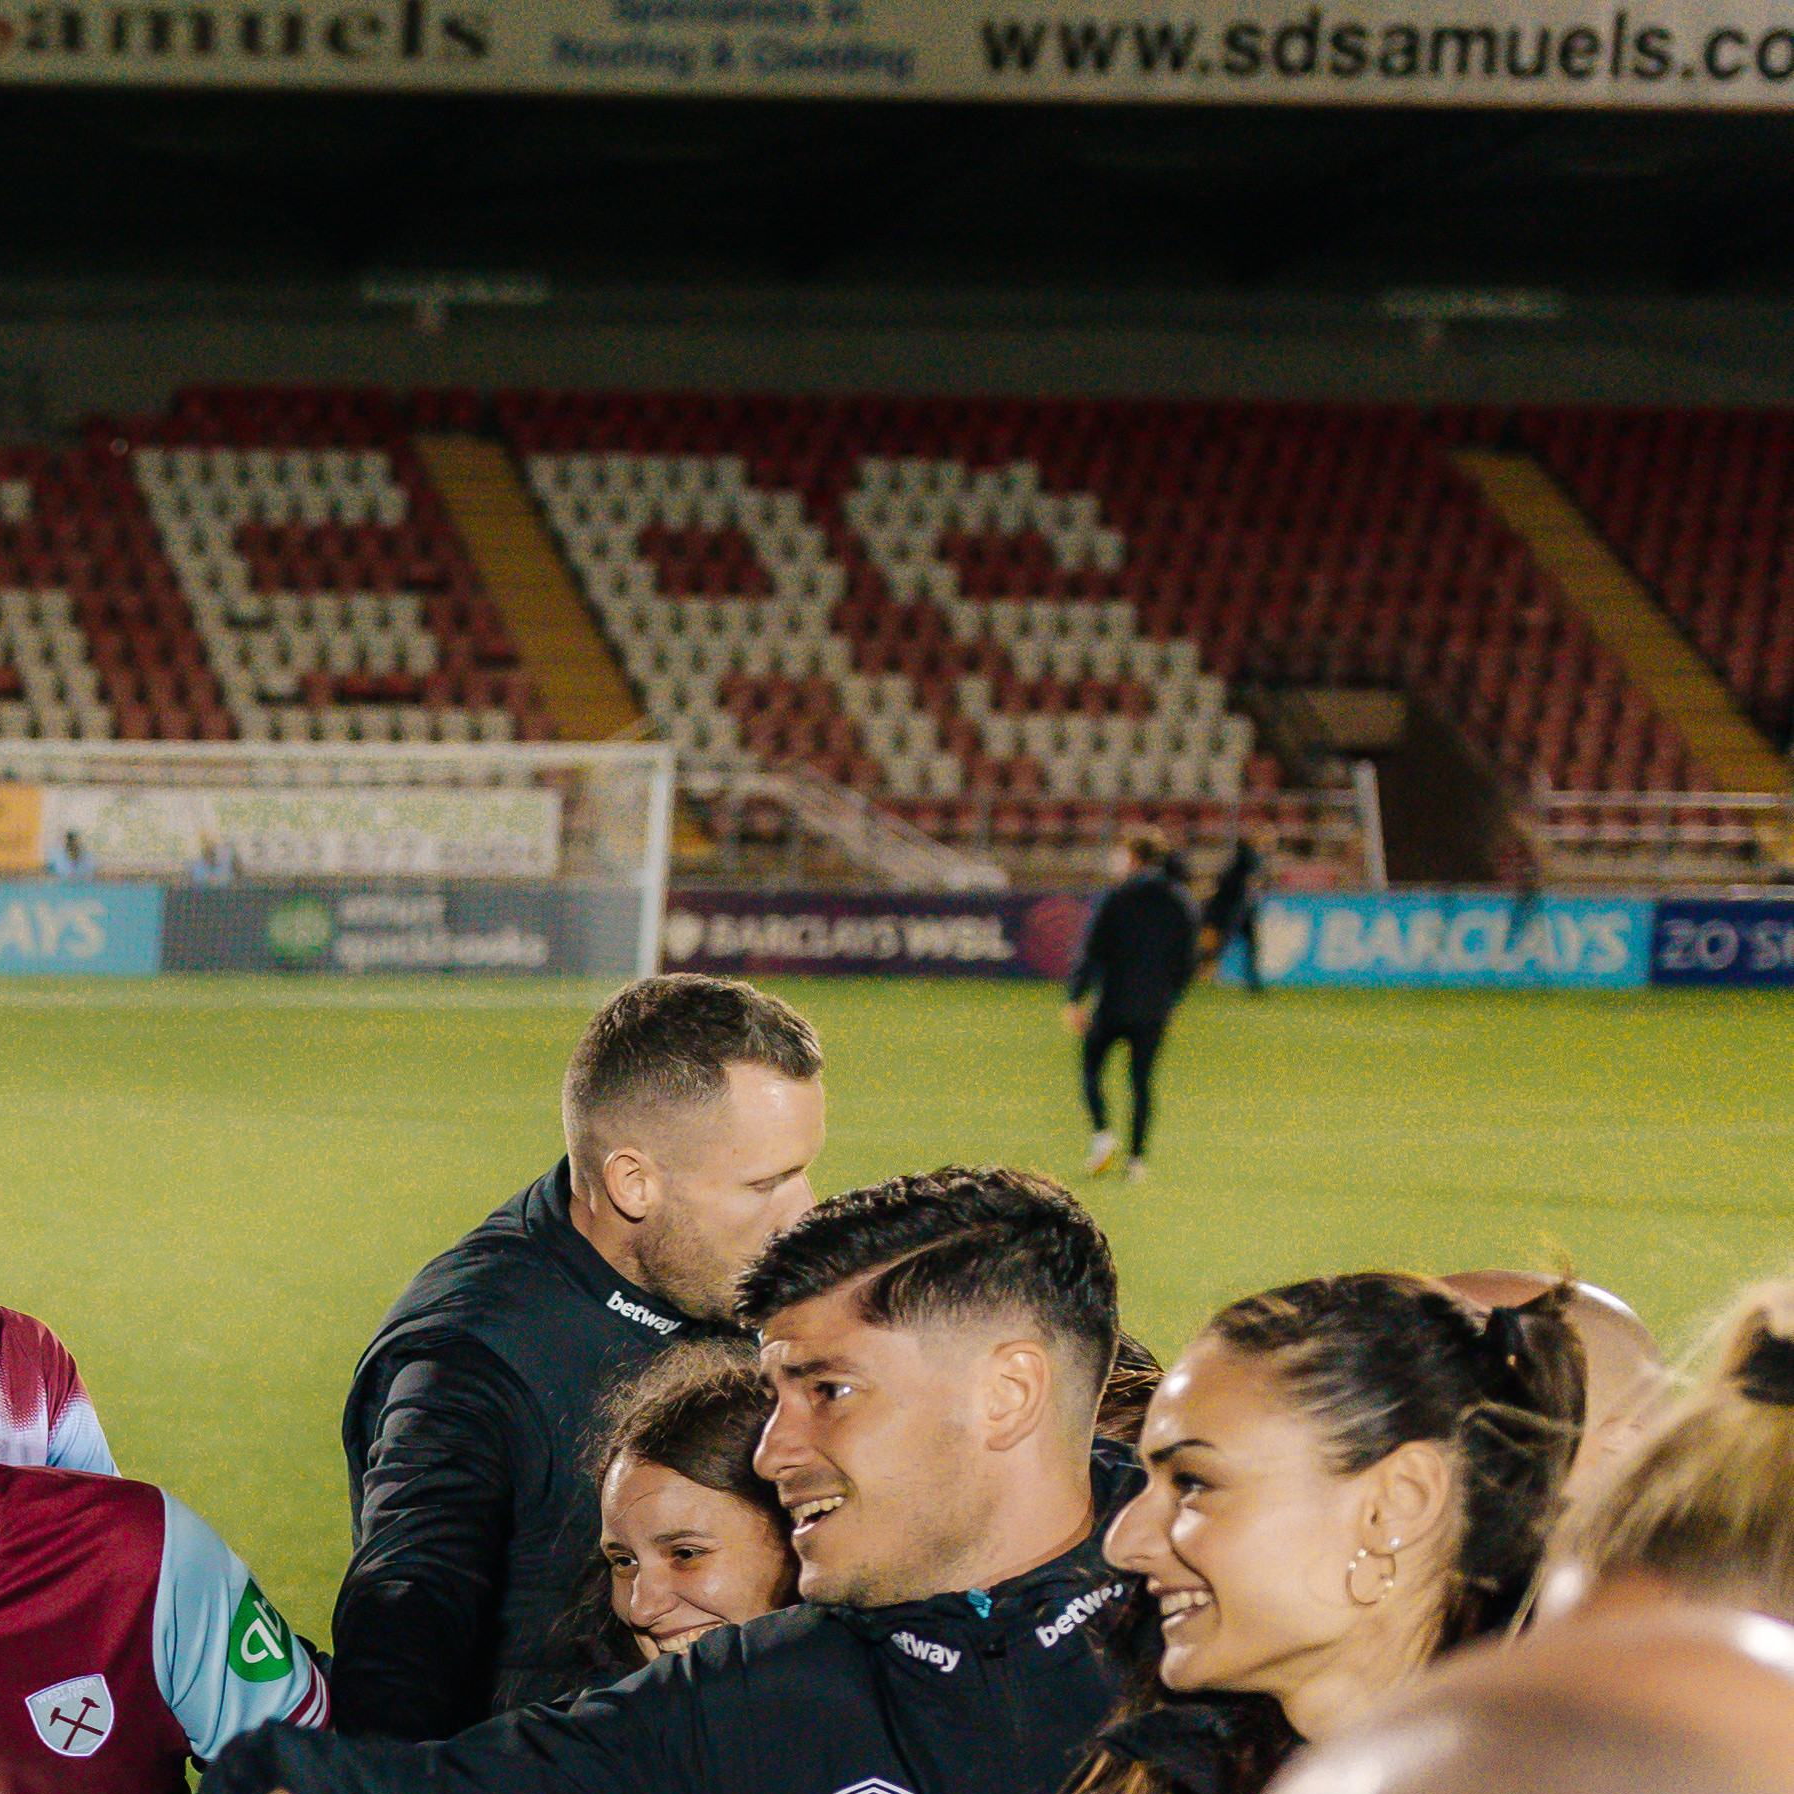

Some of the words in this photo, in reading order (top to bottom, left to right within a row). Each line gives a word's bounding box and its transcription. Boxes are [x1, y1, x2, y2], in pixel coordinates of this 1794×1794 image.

[703, 911, 901, 961] BARCLAYS
[1315, 907, 1630, 975] BARCLAYS
[1750, 919, 1794, 973] S
[605, 1290, 683, 1336] betway
[890, 1631, 962, 1673] tway
